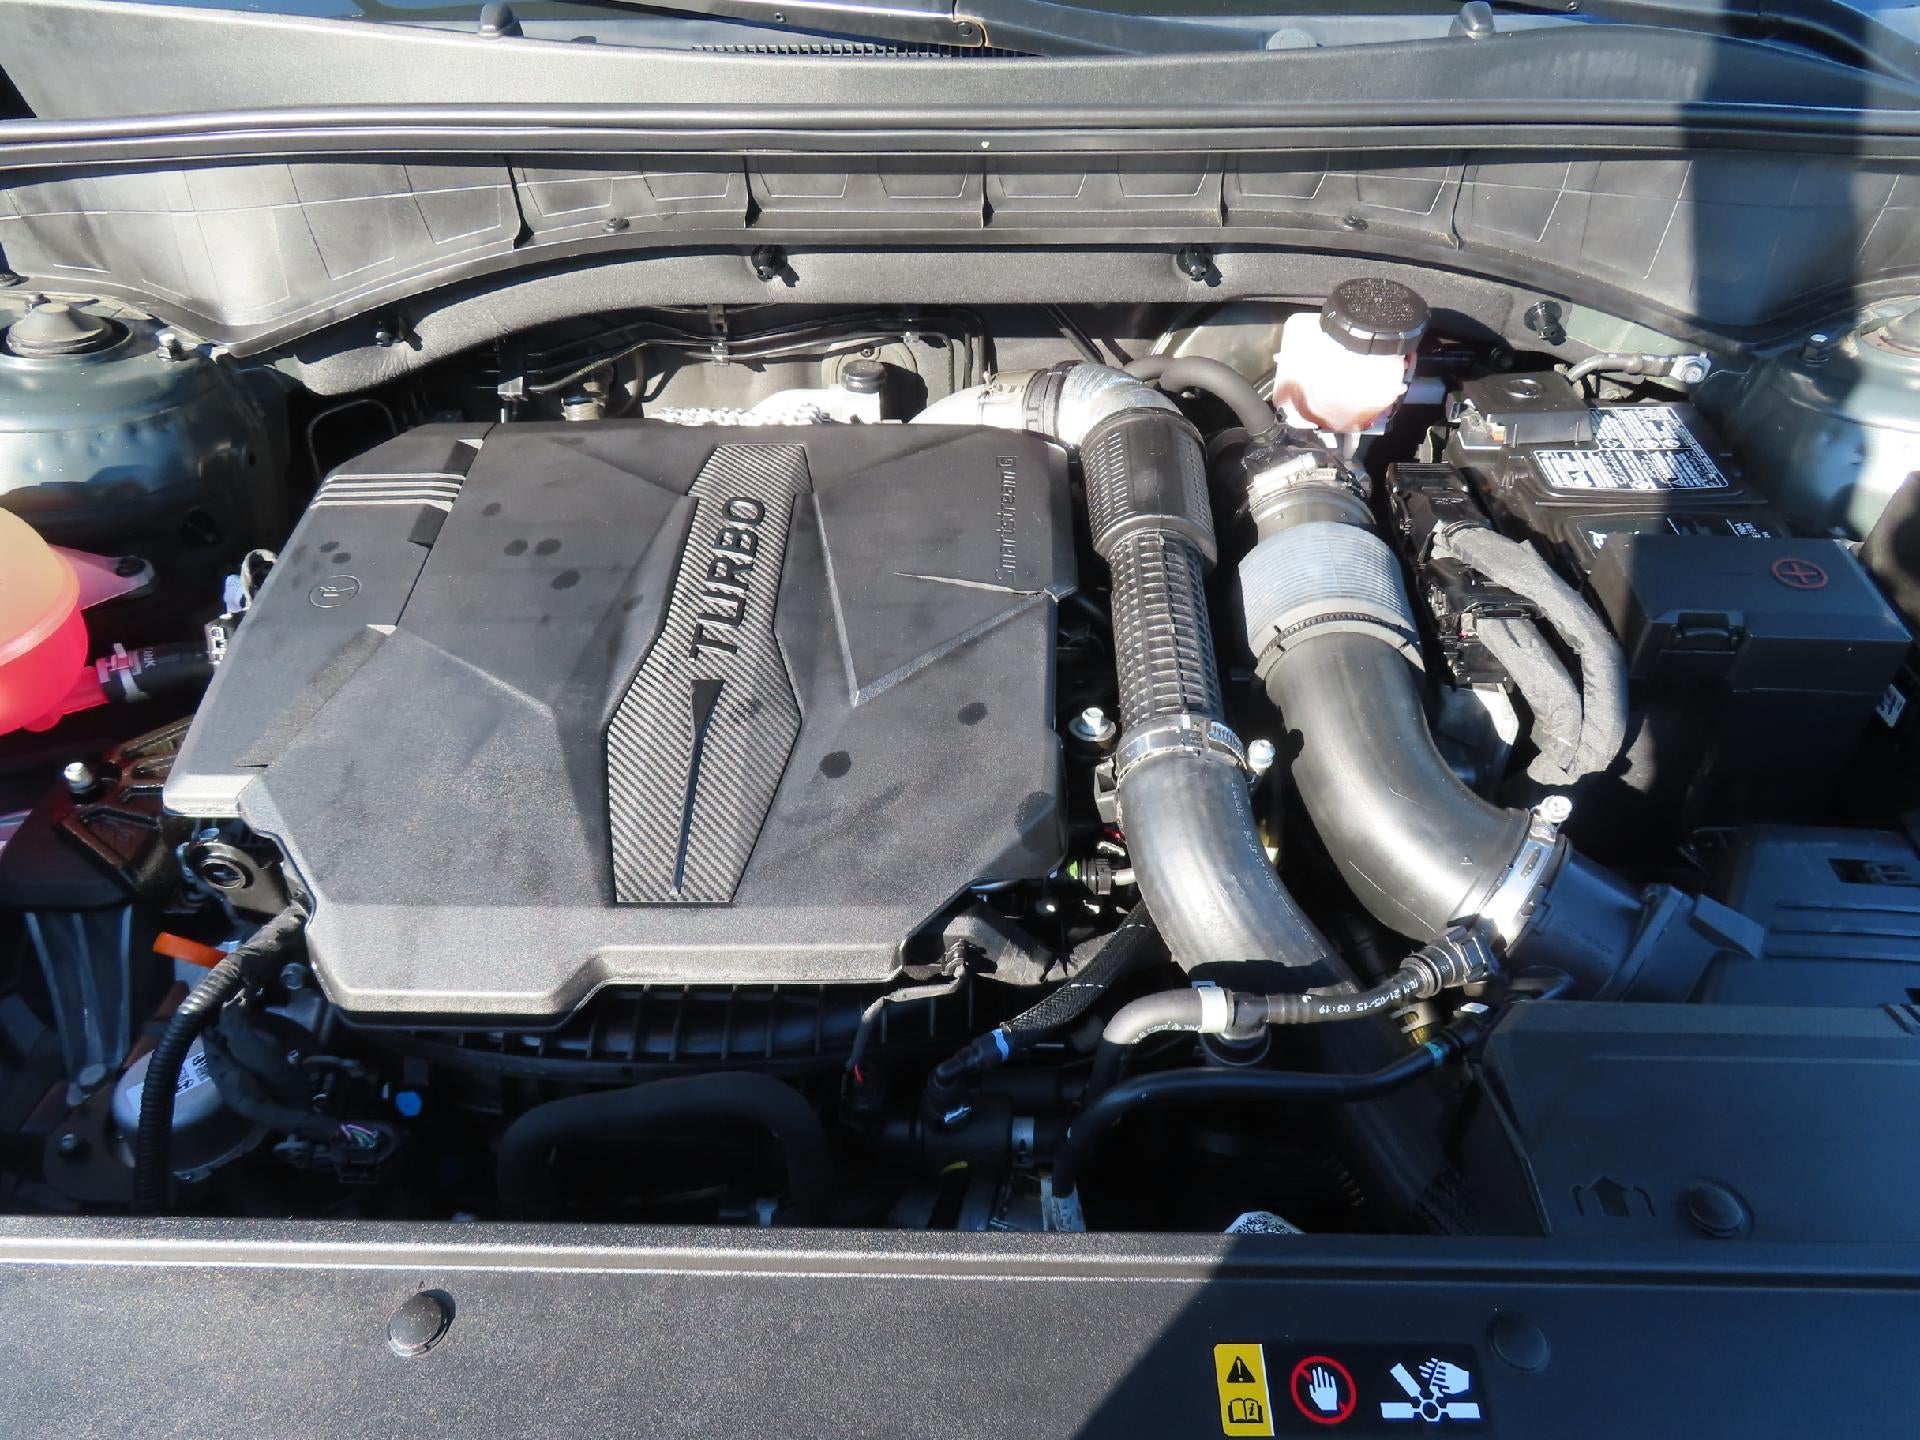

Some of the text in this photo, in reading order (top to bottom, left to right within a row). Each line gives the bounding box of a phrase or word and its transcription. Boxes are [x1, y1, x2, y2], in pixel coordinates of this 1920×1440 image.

[689, 496, 766, 661] TURBO
[995, 470, 1016, 584] Smartstream
[1319, 1004, 1350, 1014] 03:19
